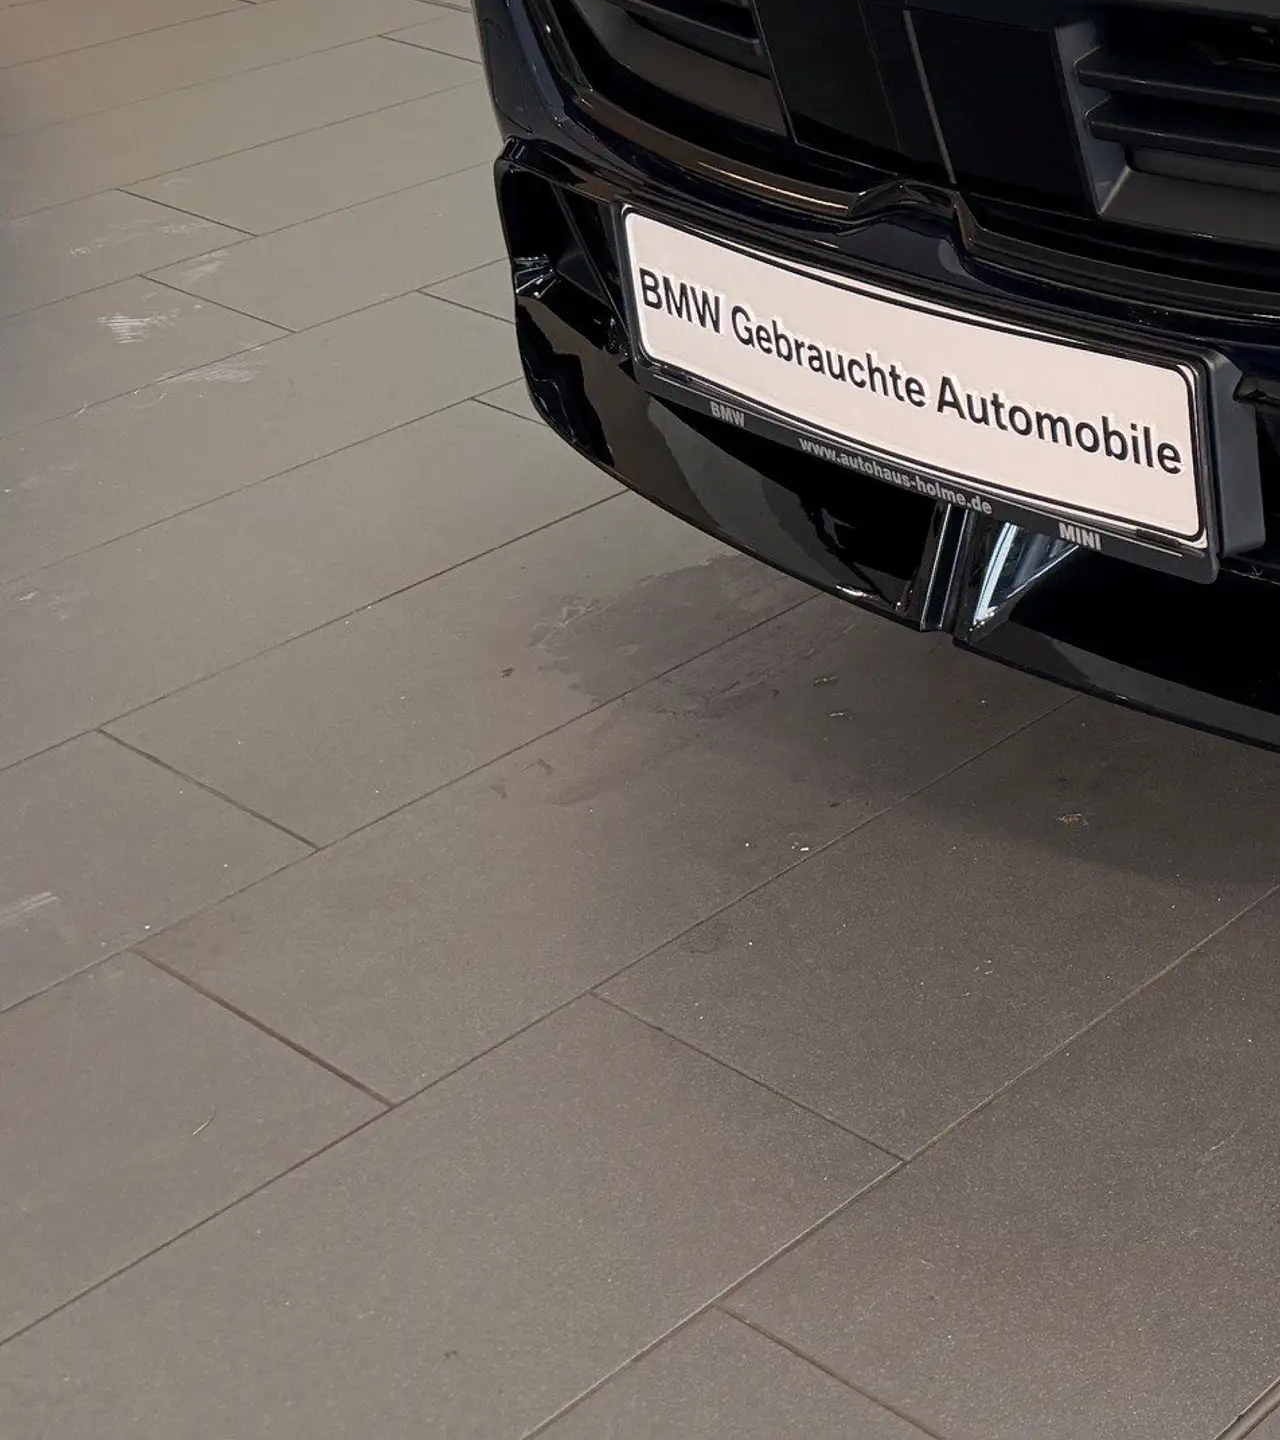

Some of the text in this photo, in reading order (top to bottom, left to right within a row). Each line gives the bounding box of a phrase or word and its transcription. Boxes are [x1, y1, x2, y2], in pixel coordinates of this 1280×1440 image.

[639, 267, 1182, 475] BMW Gebrauchte Automobile
[710, 400, 1102, 550] BMW www.autohaus-holme.de MINI
